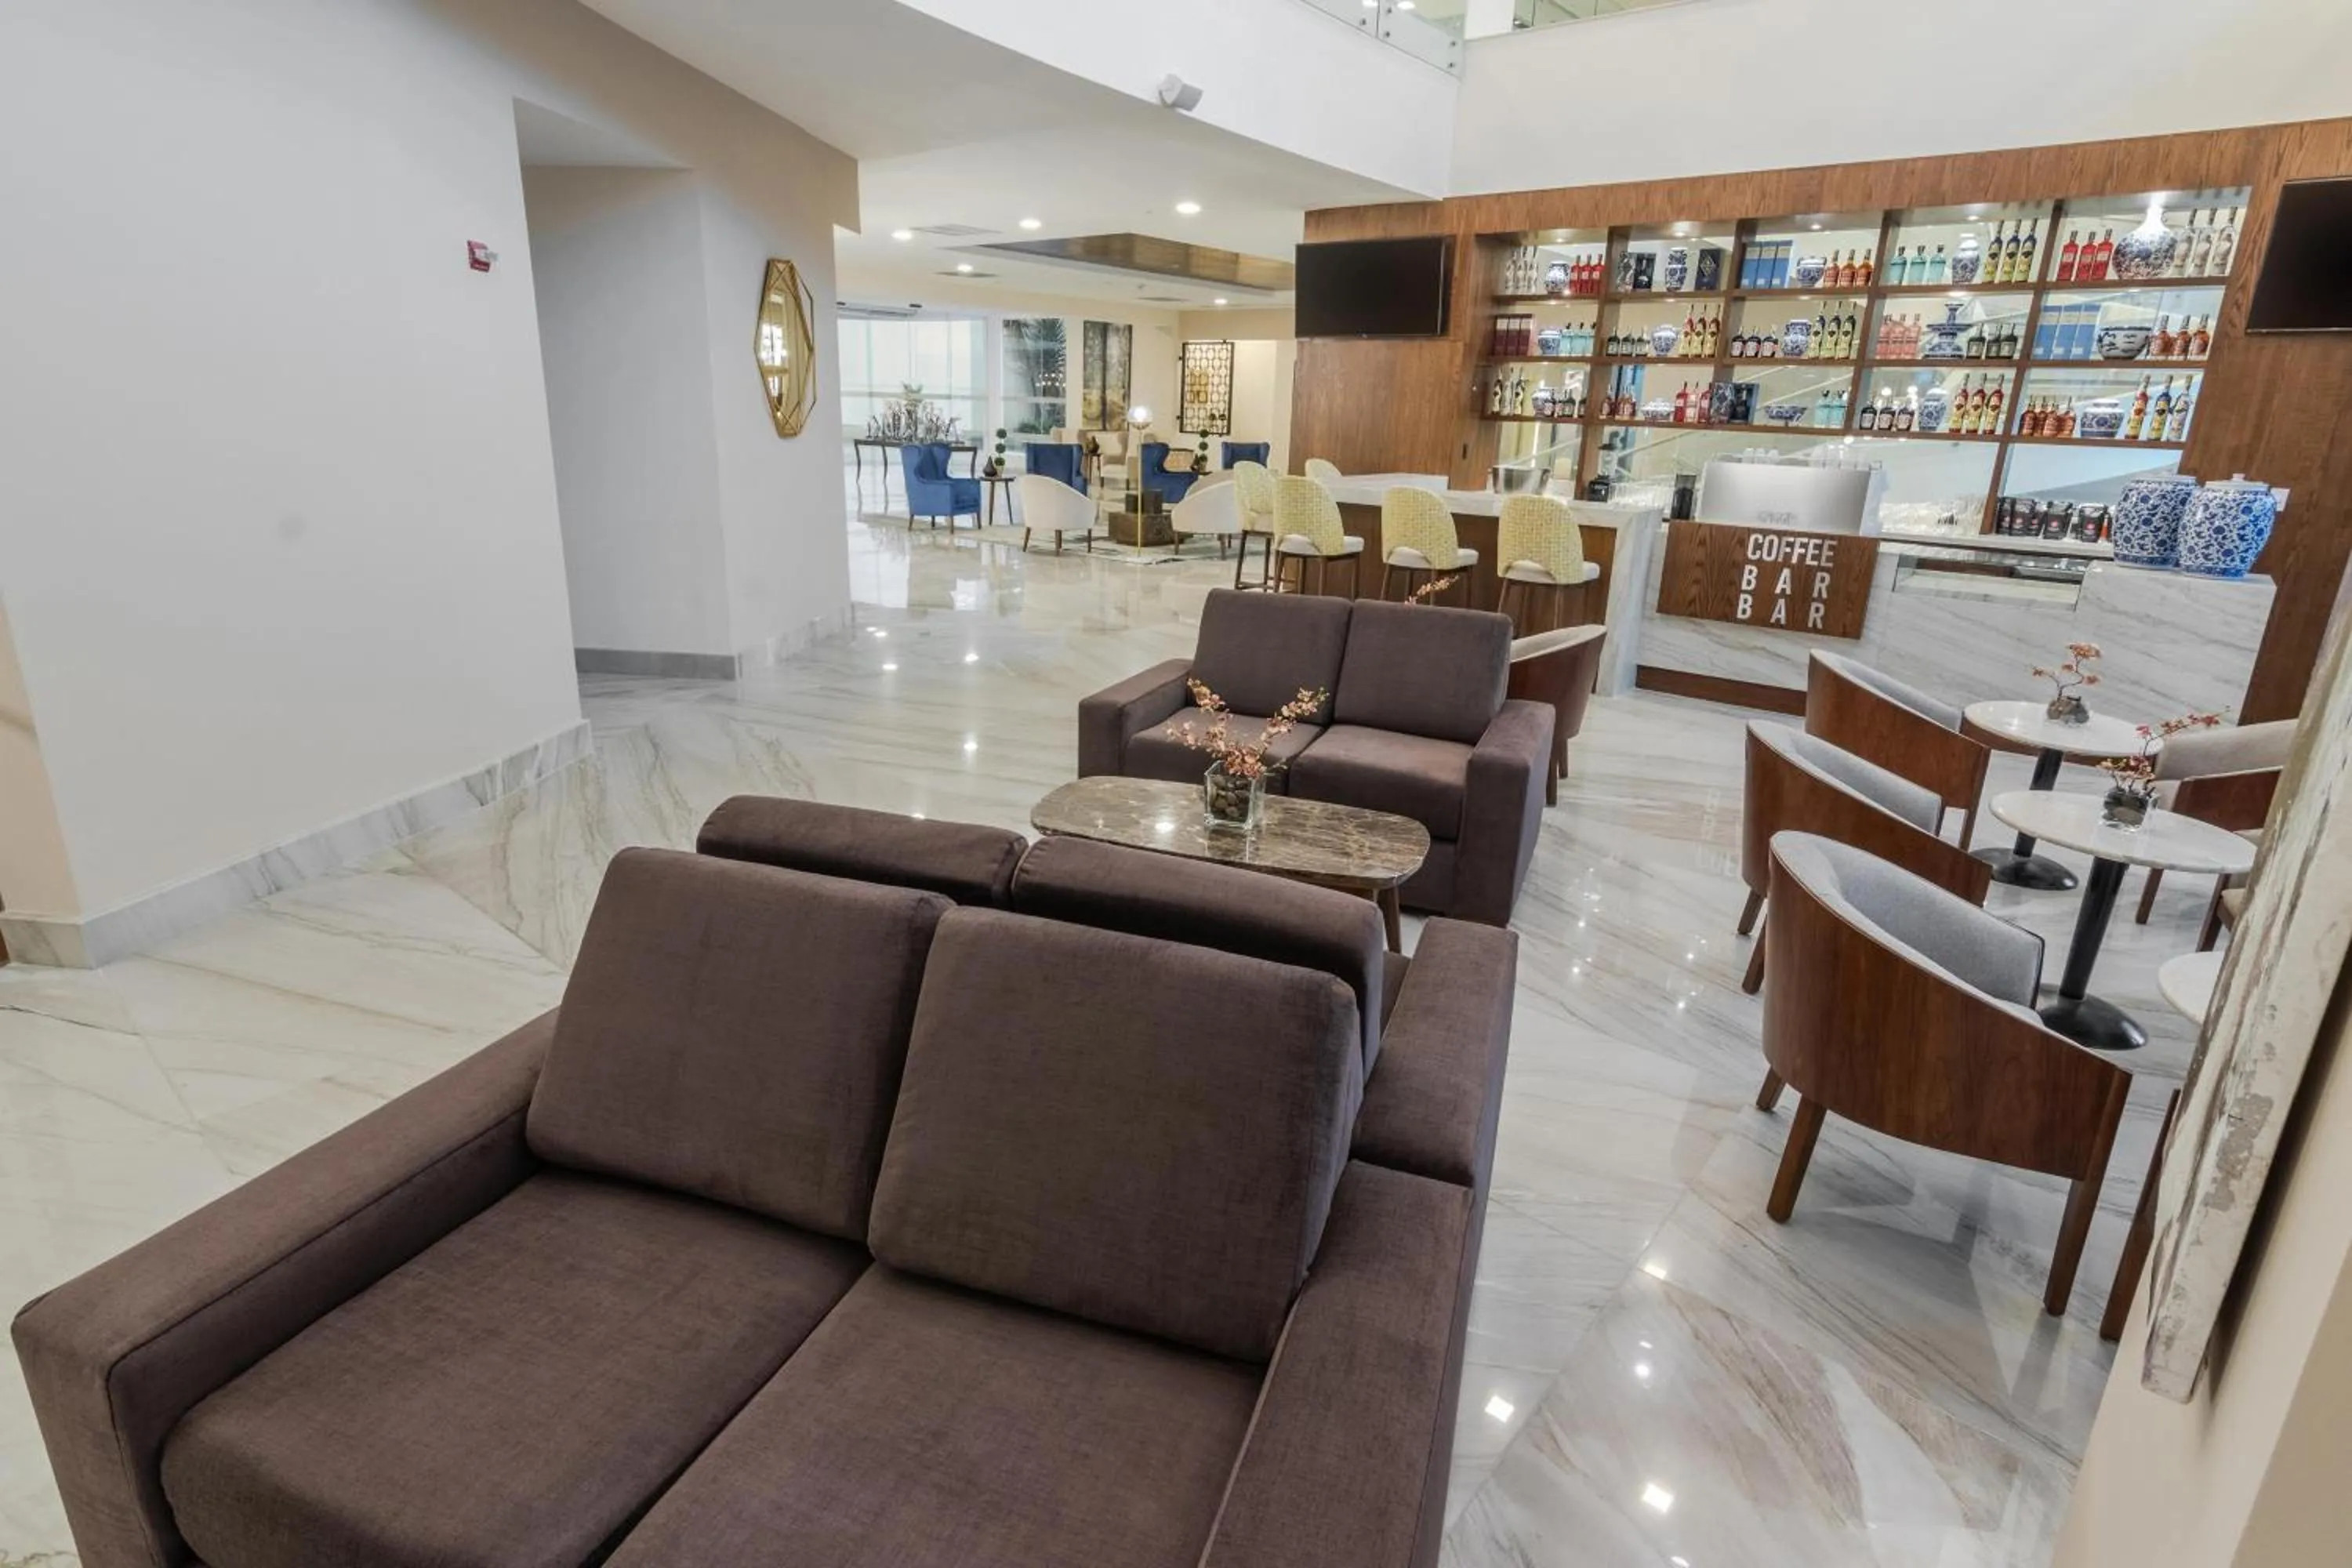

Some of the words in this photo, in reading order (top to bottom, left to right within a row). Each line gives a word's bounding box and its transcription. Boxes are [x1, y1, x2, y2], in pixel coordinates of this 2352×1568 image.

[1747, 533, 1838, 567] COFFEE
[1741, 564, 1831, 599] BAR
[1737, 593, 1825, 630] BAR
